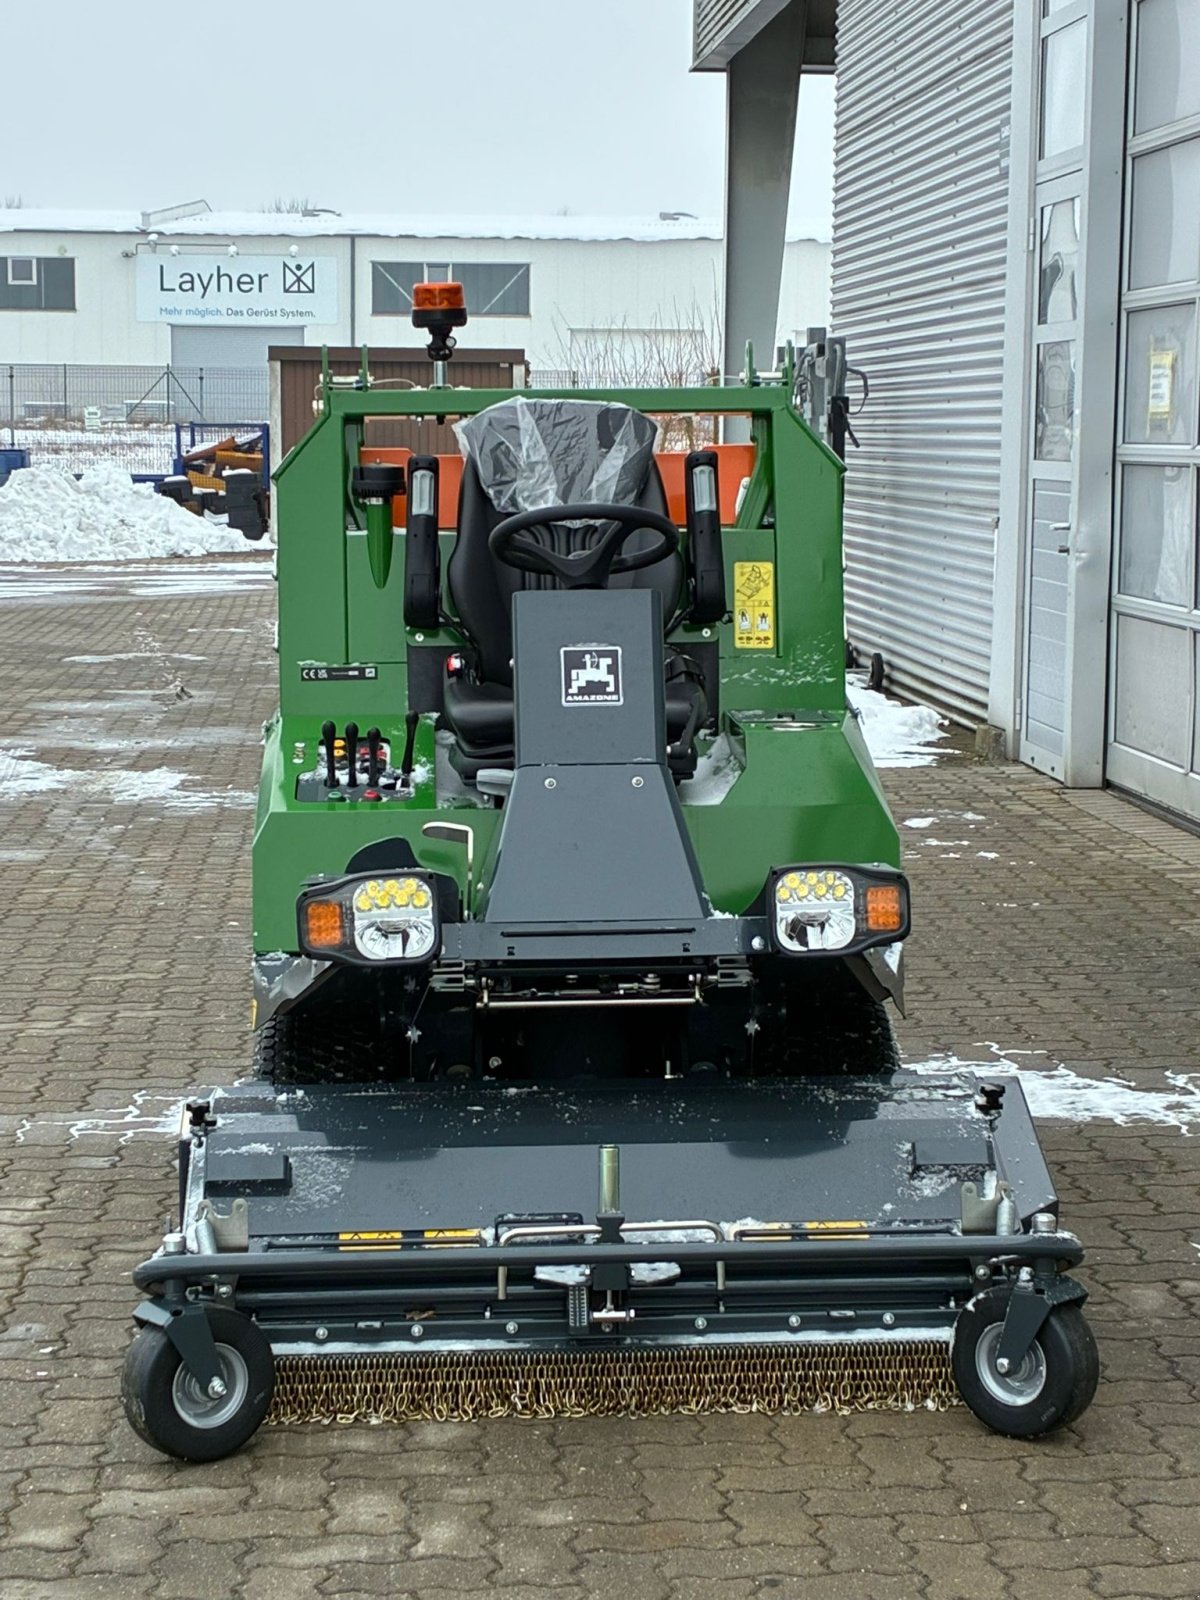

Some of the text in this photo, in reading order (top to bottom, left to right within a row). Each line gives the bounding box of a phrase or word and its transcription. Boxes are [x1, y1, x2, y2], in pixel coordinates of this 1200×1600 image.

[159, 264, 269, 299] Layher
[159, 306, 316, 320] Mehr möglich. Das Gerüst System.
[302, 669, 316, 679] CE
